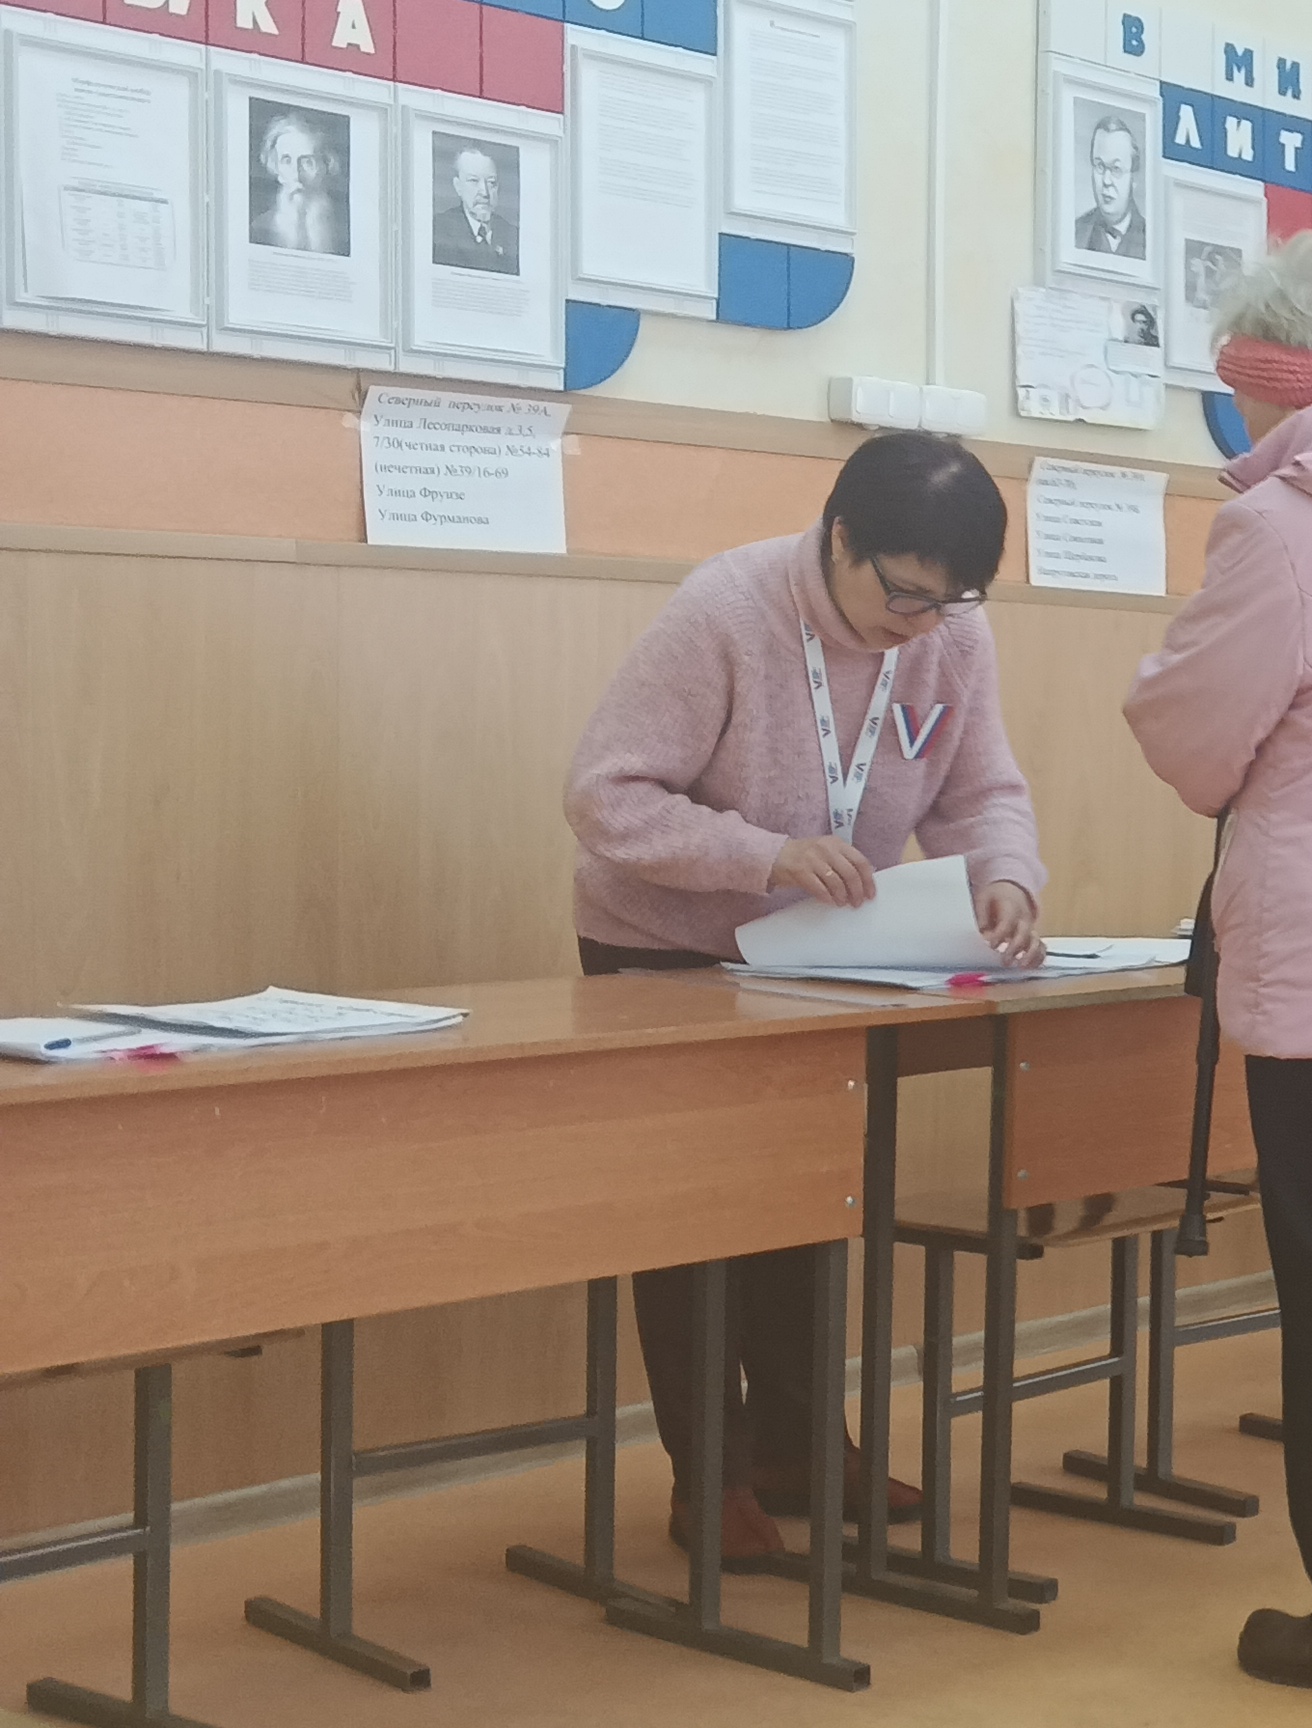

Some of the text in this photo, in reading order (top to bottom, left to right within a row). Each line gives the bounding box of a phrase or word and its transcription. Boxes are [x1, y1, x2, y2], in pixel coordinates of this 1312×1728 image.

[1121, 13, 1146, 57] В
[377, 392, 442, 409] Северный
[373, 414, 413, 430] Улица
[417, 418, 502, 436] Лесопарковая
[449, 443, 502, 458] сторона)
[374, 462, 441, 477] (нечетная)
[376, 484, 466, 502] Улица Фрунзе
[378, 508, 490, 526] Улица Фурманова
[892, 703, 956, 761] V
